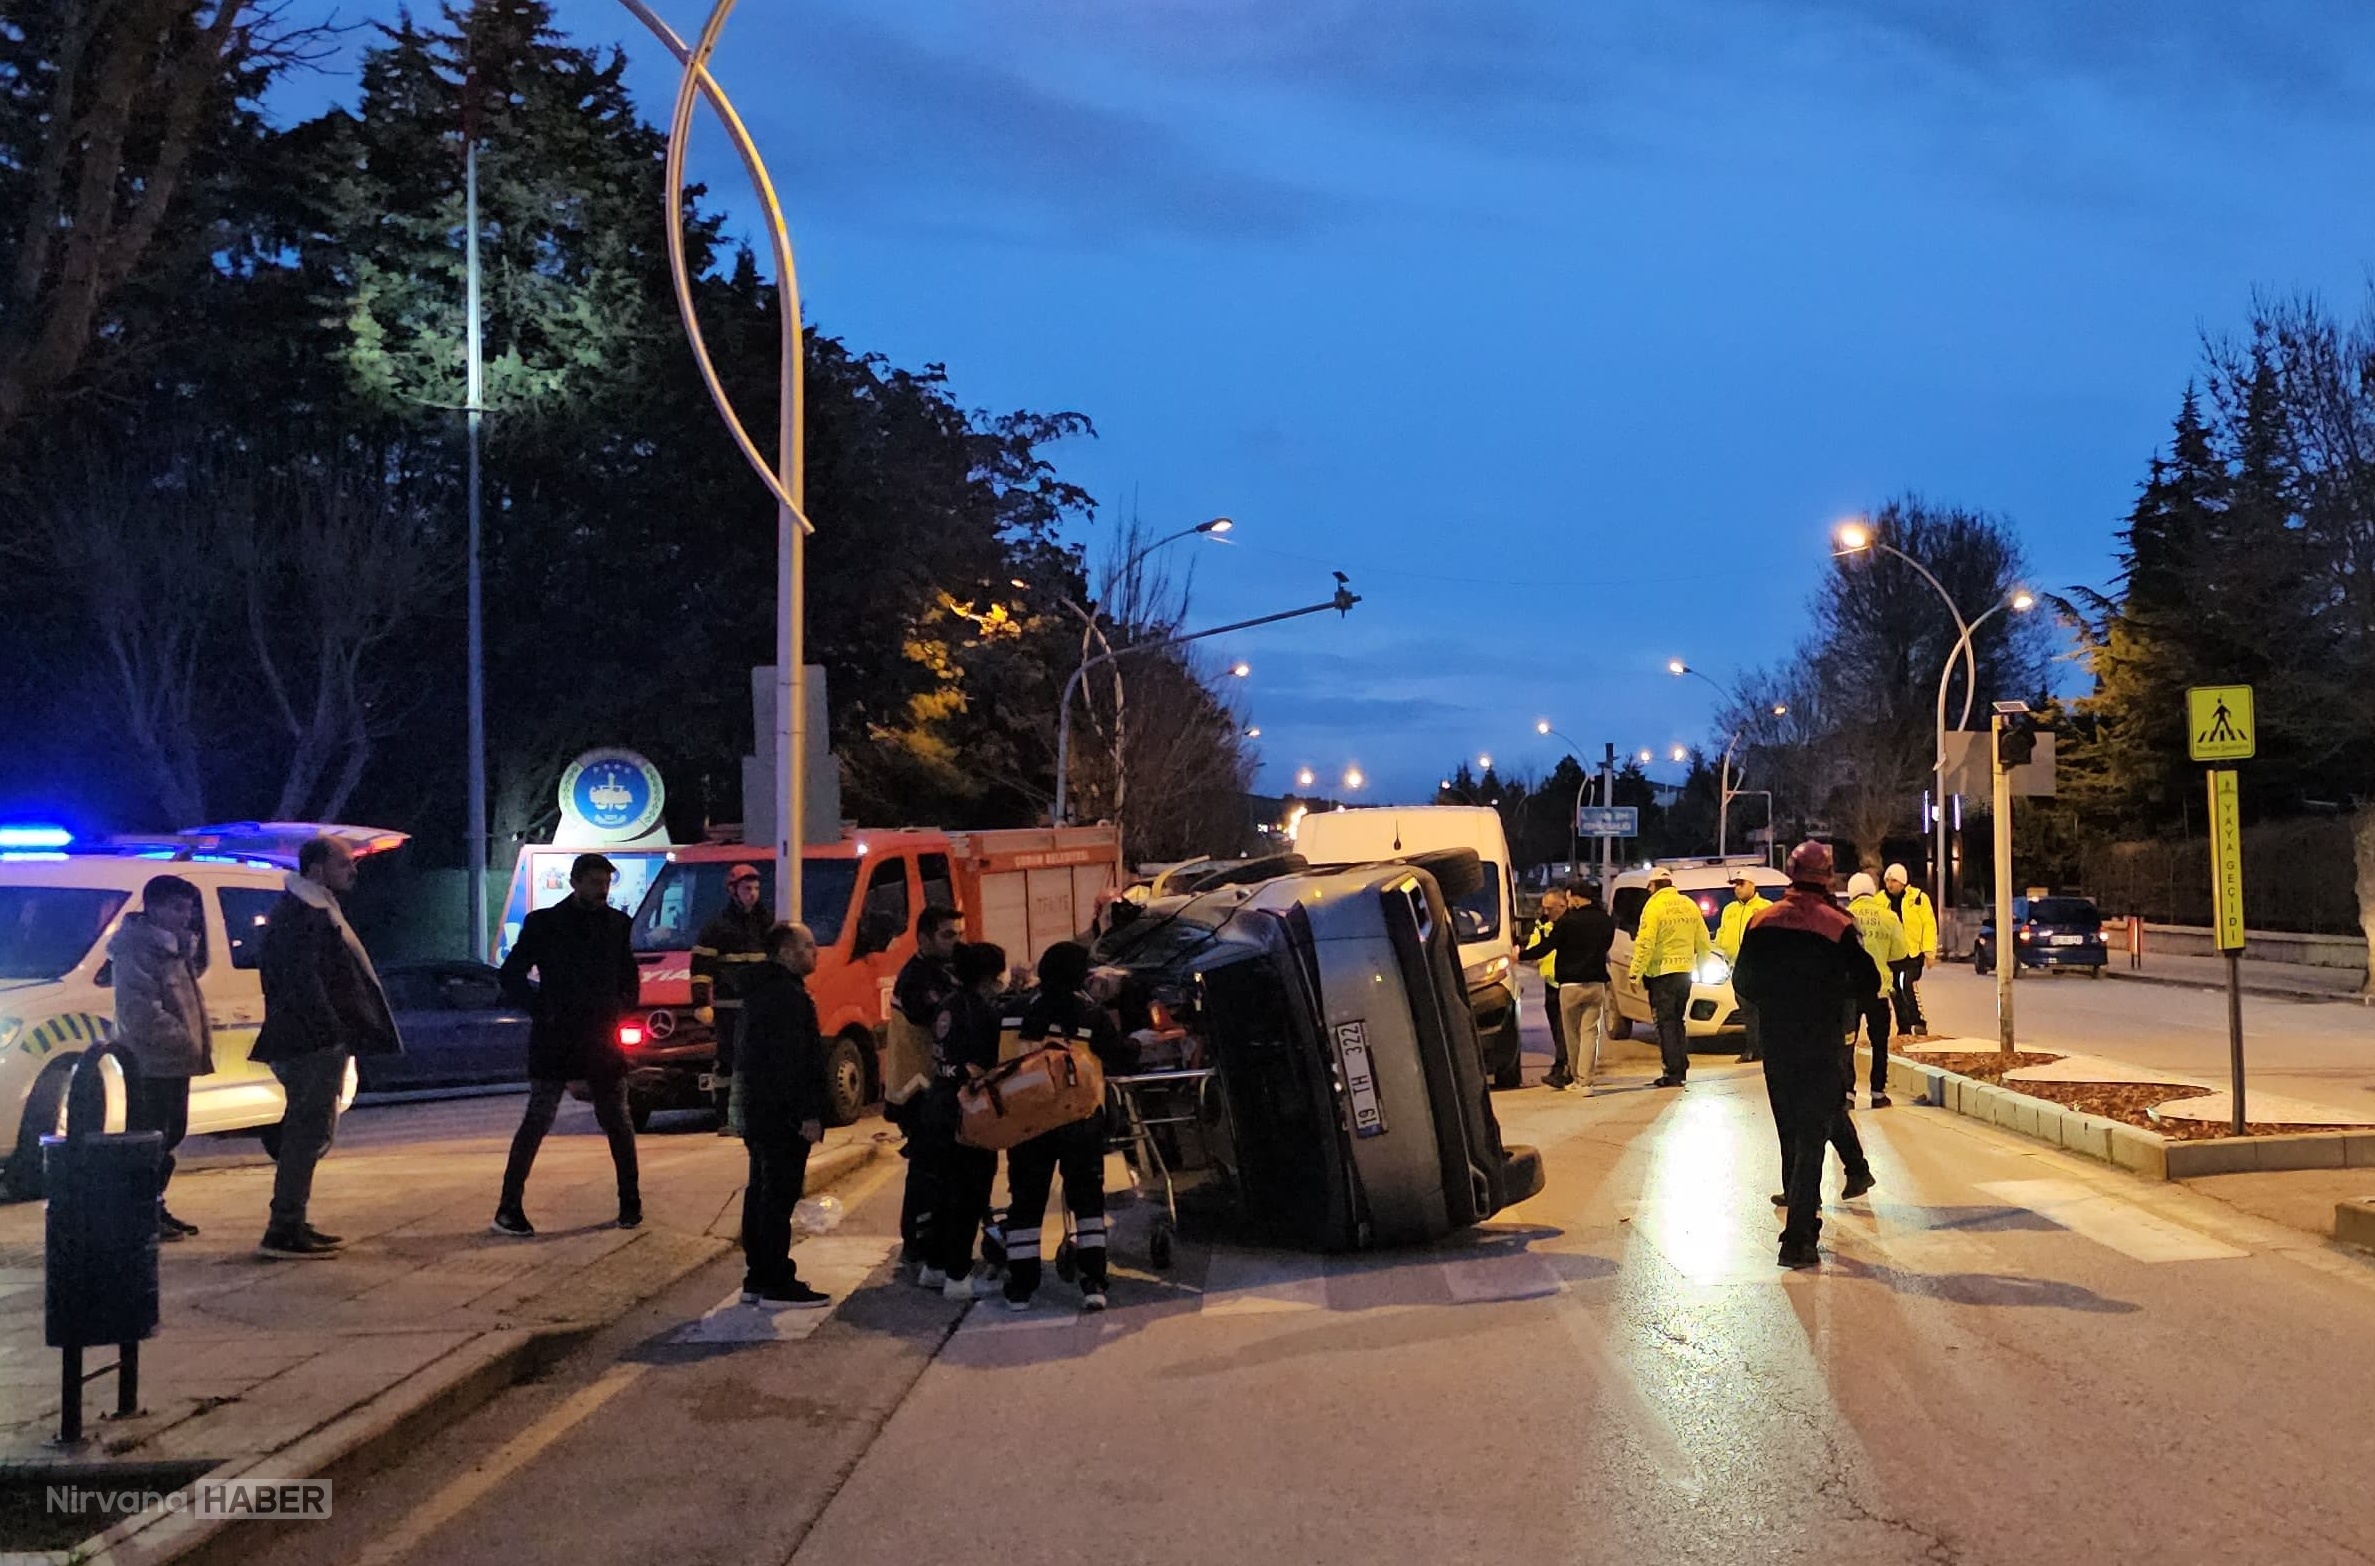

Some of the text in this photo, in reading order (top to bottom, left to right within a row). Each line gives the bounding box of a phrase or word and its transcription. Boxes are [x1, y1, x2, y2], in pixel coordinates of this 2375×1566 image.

[2224, 803, 2234, 851] YAYA
[1341, 1025, 1377, 1125] 19 TH 322
